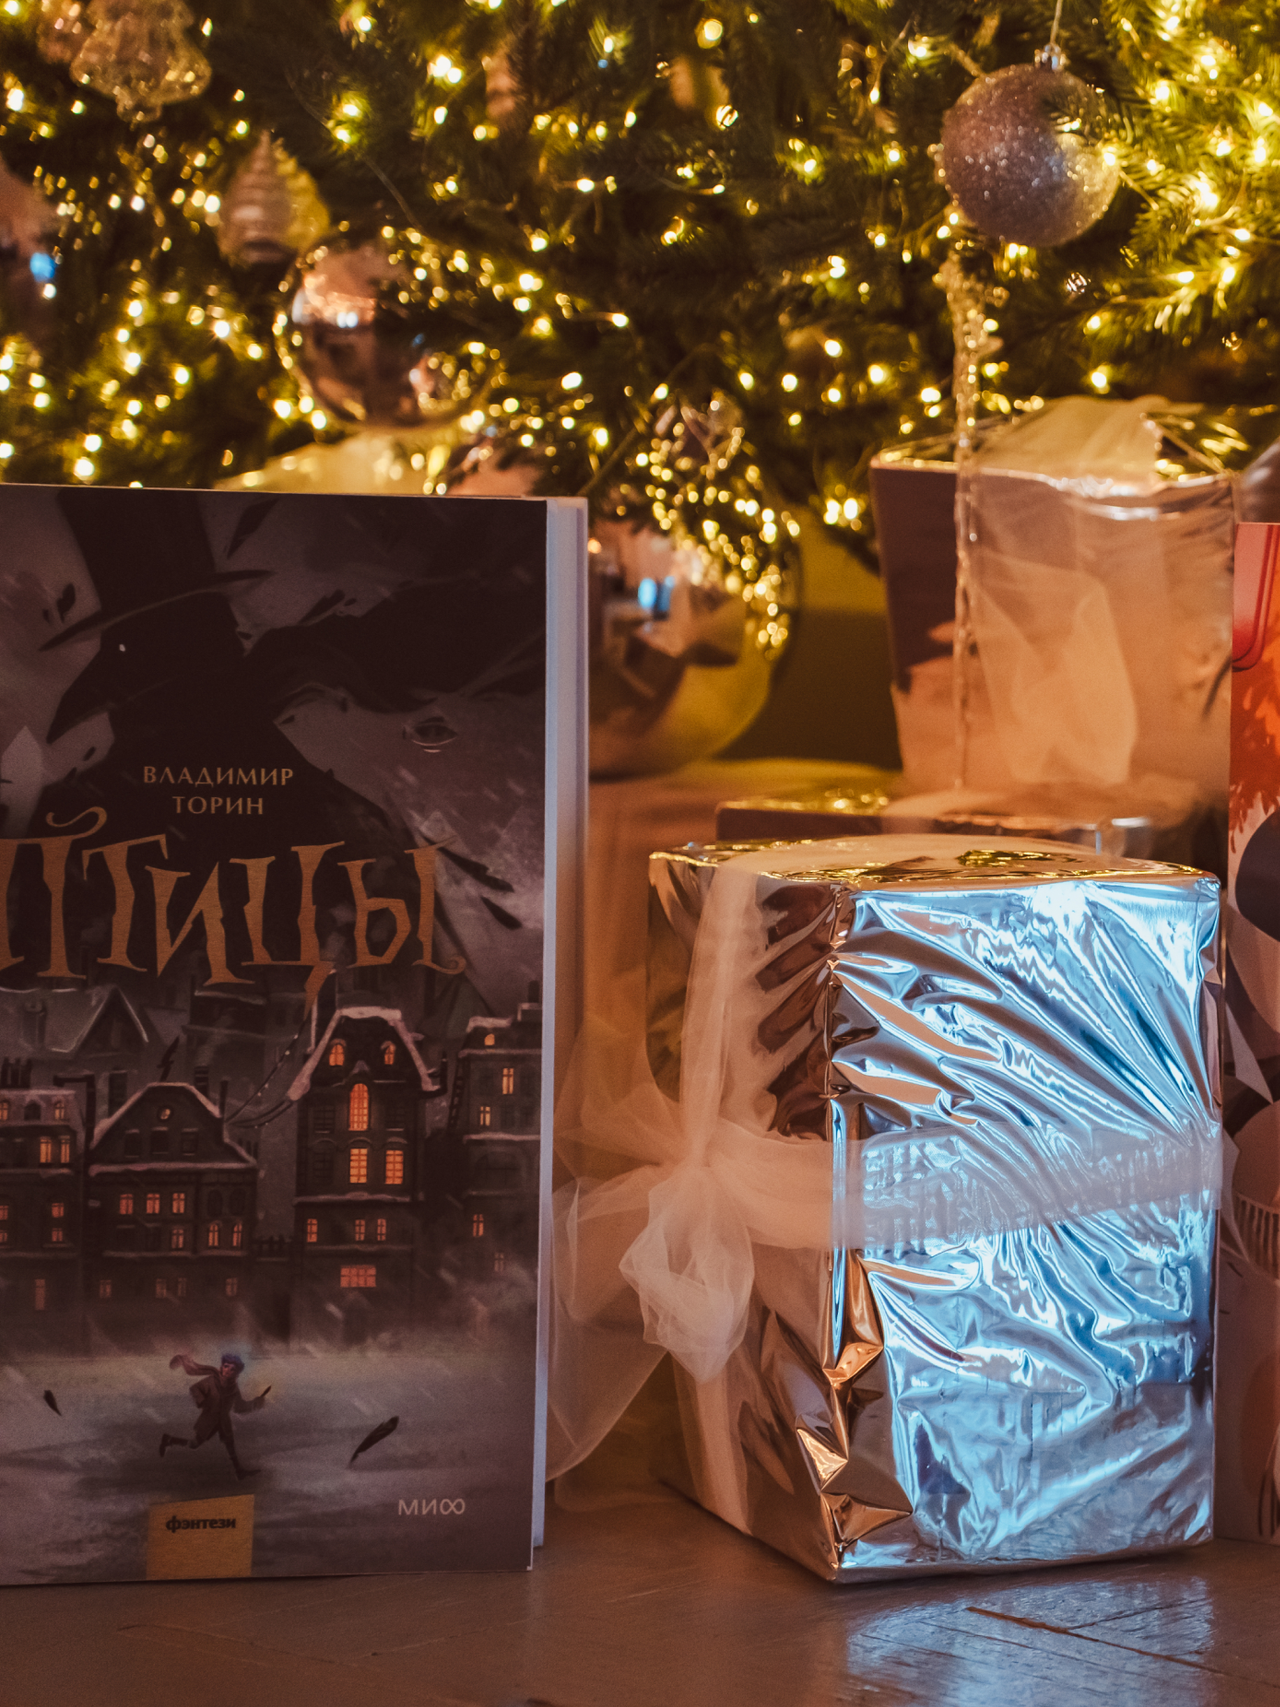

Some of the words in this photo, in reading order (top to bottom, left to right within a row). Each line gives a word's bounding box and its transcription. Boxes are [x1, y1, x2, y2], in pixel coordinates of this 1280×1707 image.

[143, 765, 294, 788] ВЛАДИМИР
[172, 795, 264, 816] ТОРИН
[166, 1514, 237, 1533] фэнтези
